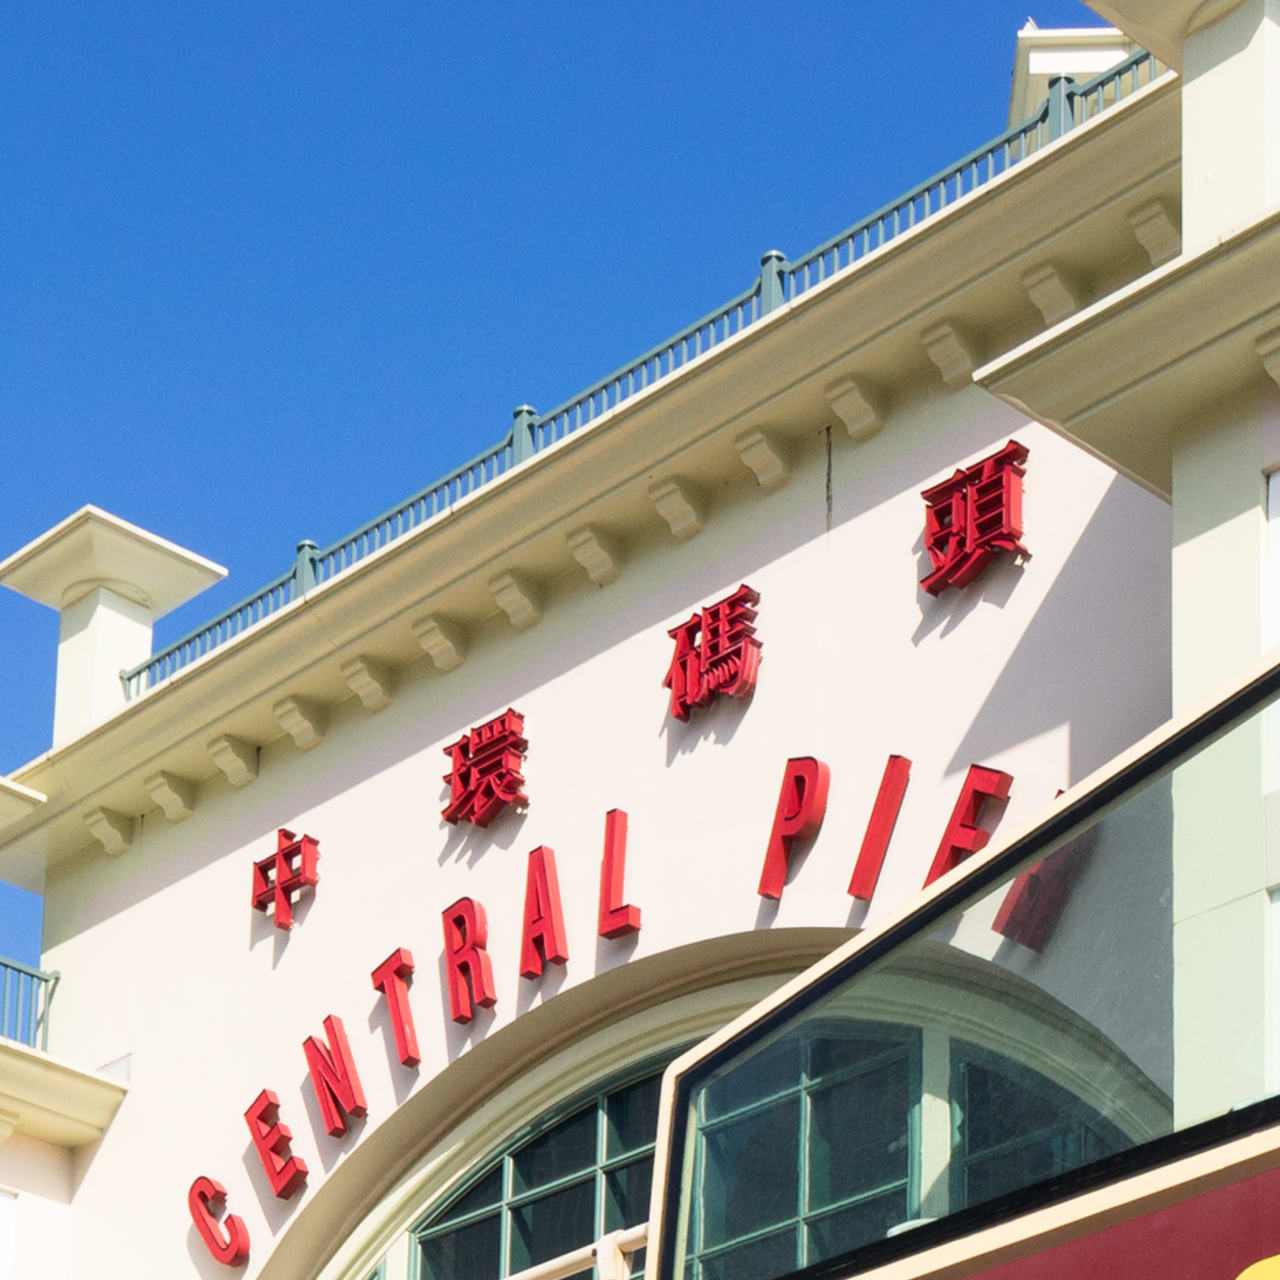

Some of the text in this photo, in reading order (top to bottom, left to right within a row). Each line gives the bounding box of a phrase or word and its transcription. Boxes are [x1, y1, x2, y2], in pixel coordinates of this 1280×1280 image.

[250, 439, 1032, 930] 中環碼頭
[189, 808, 642, 1268] CENTRAL
